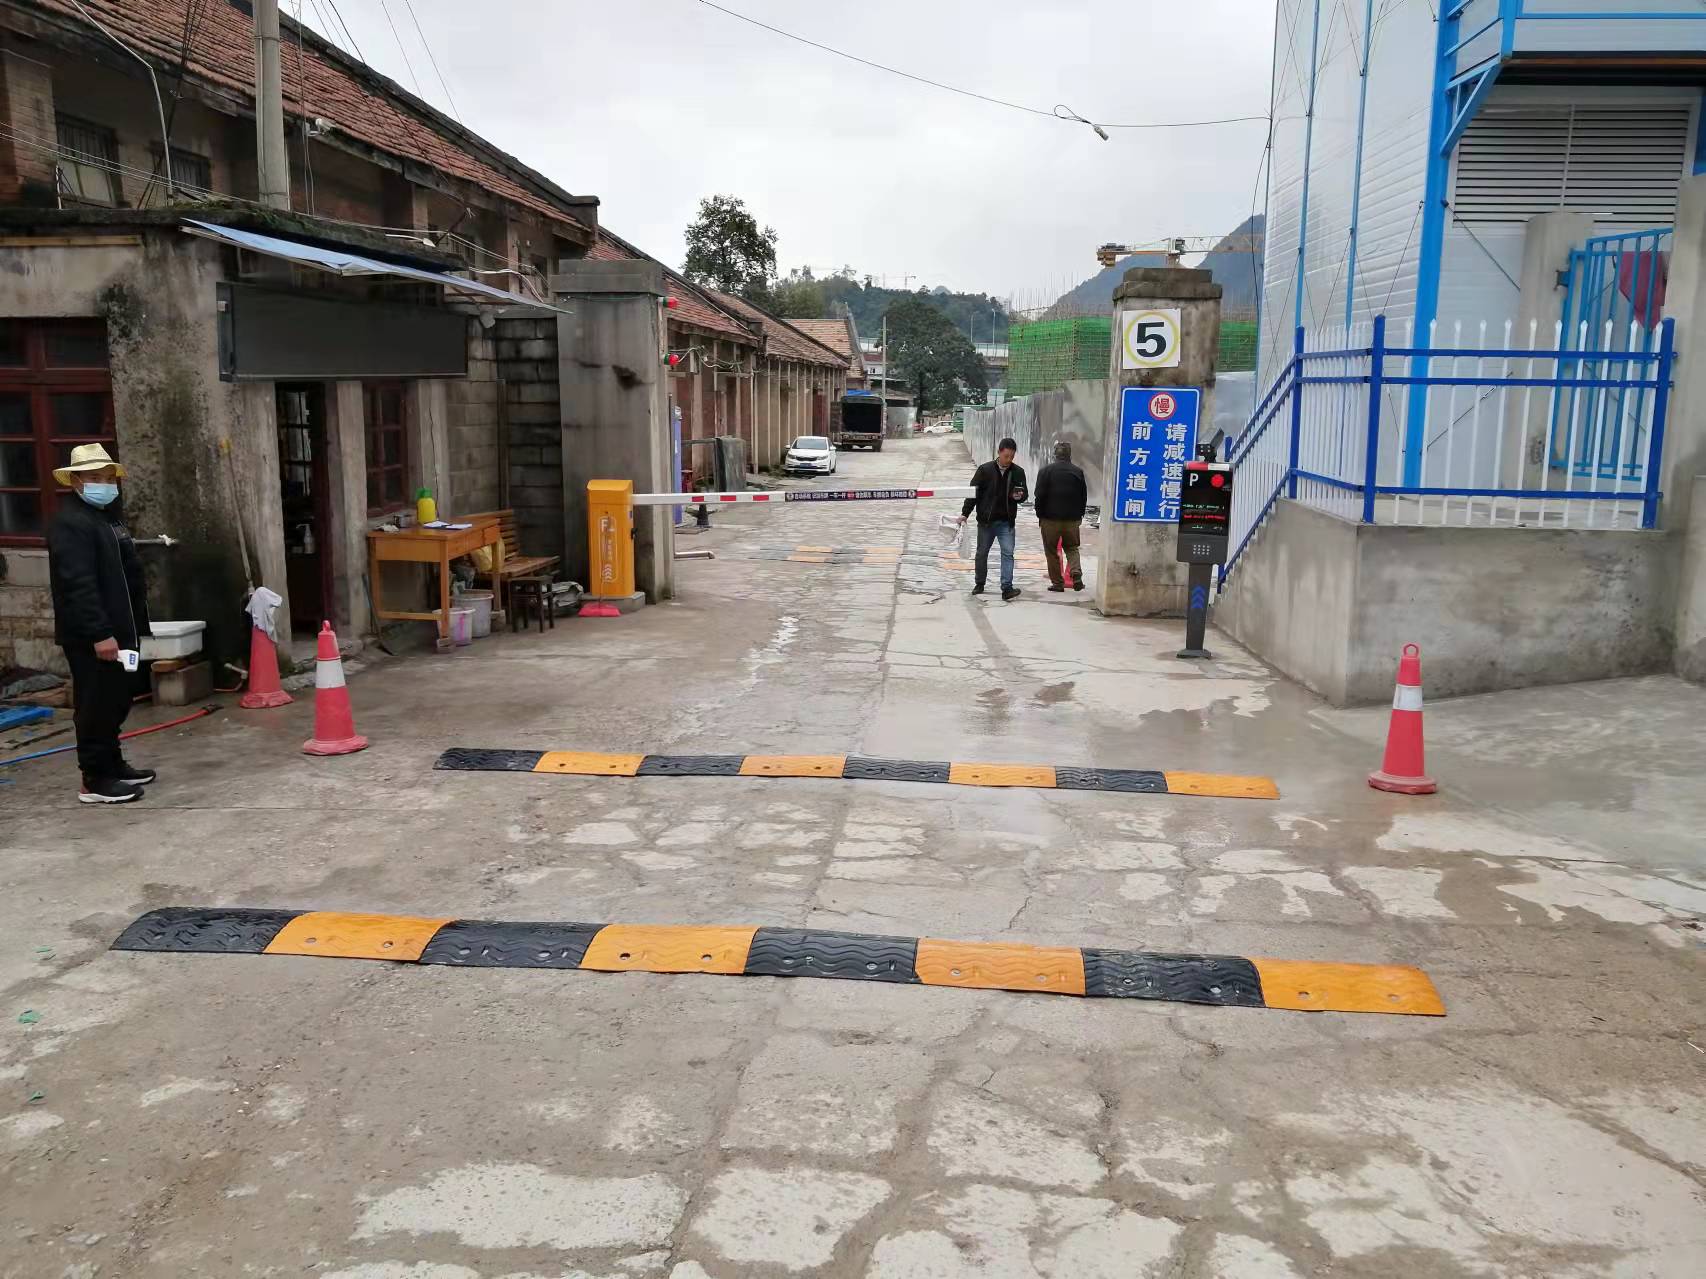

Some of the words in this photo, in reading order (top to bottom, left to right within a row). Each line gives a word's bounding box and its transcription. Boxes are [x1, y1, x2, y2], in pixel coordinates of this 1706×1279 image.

[1136, 321, 1167, 358] 5
[1154, 397, 1170, 414] 慢
[1124, 421, 1153, 517] 前方道闸
[1158, 422, 1187, 519] 请减速慢行
[1189, 472, 1199, 487] P
